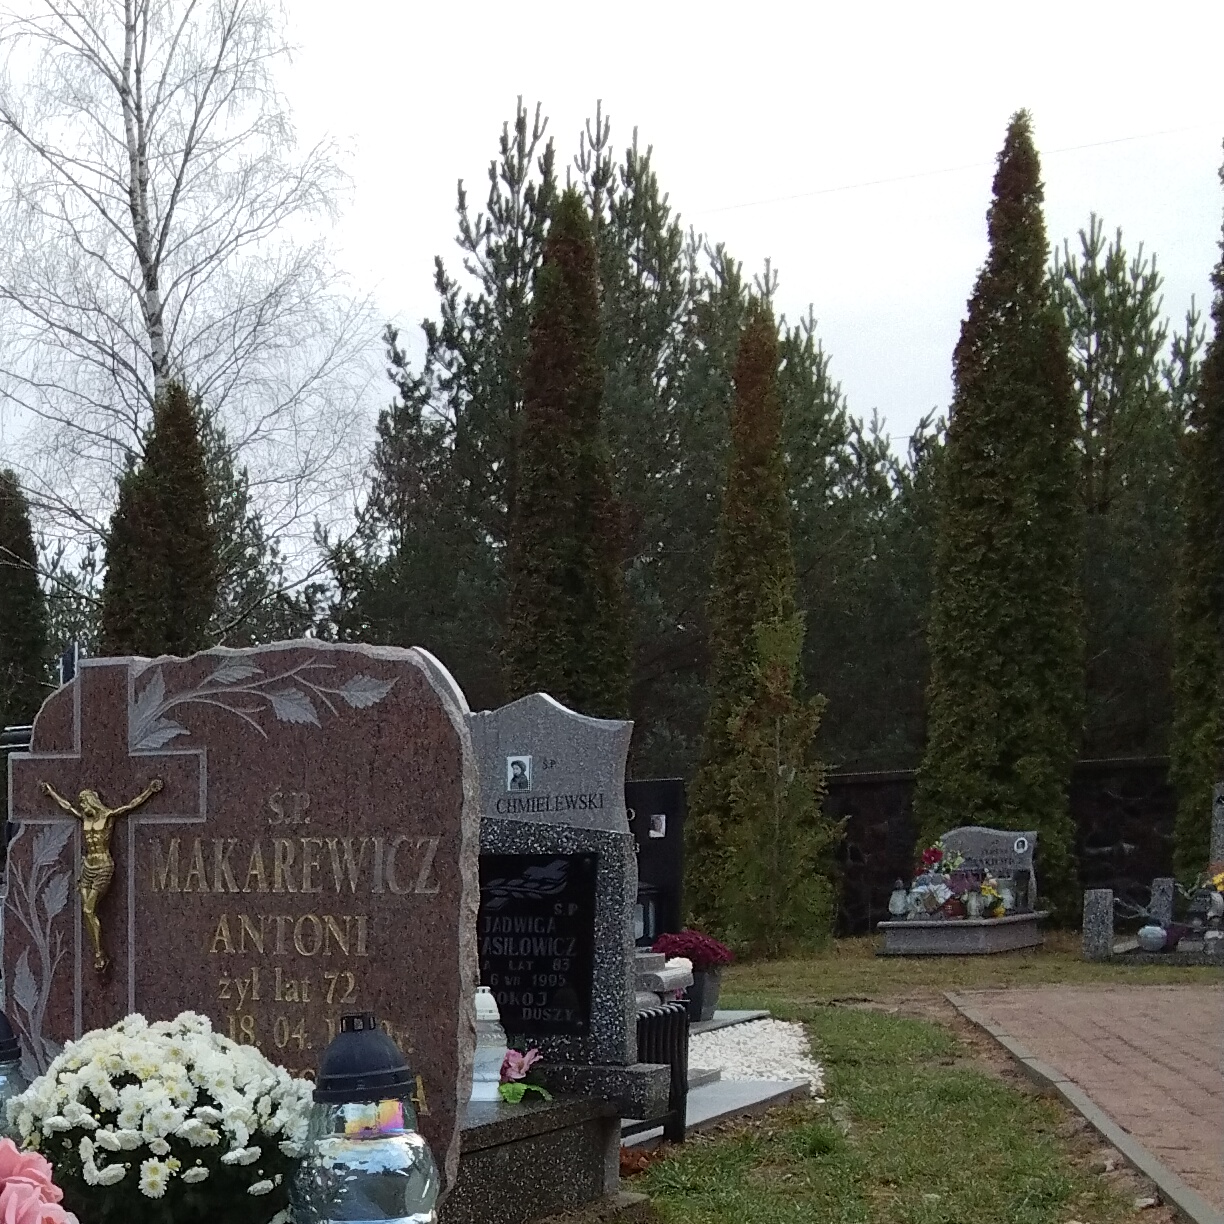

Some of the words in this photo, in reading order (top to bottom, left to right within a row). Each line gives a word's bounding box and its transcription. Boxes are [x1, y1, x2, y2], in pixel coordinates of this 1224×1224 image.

[496, 793, 605, 814] CHMIELEWSKI
[149, 835, 441, 895] MAKAREWICZ
[210, 913, 370, 957] ANTONI
[483, 916, 556, 934] JADWIGA
[508, 960, 535, 971] LAT
[274, 966, 312, 1003] lat
[324, 970, 358, 1004] 72
[522, 1007, 574, 1021] DUSZY
[228, 1014, 262, 1047] 18.
[274, 1015, 313, 1050] 04.
